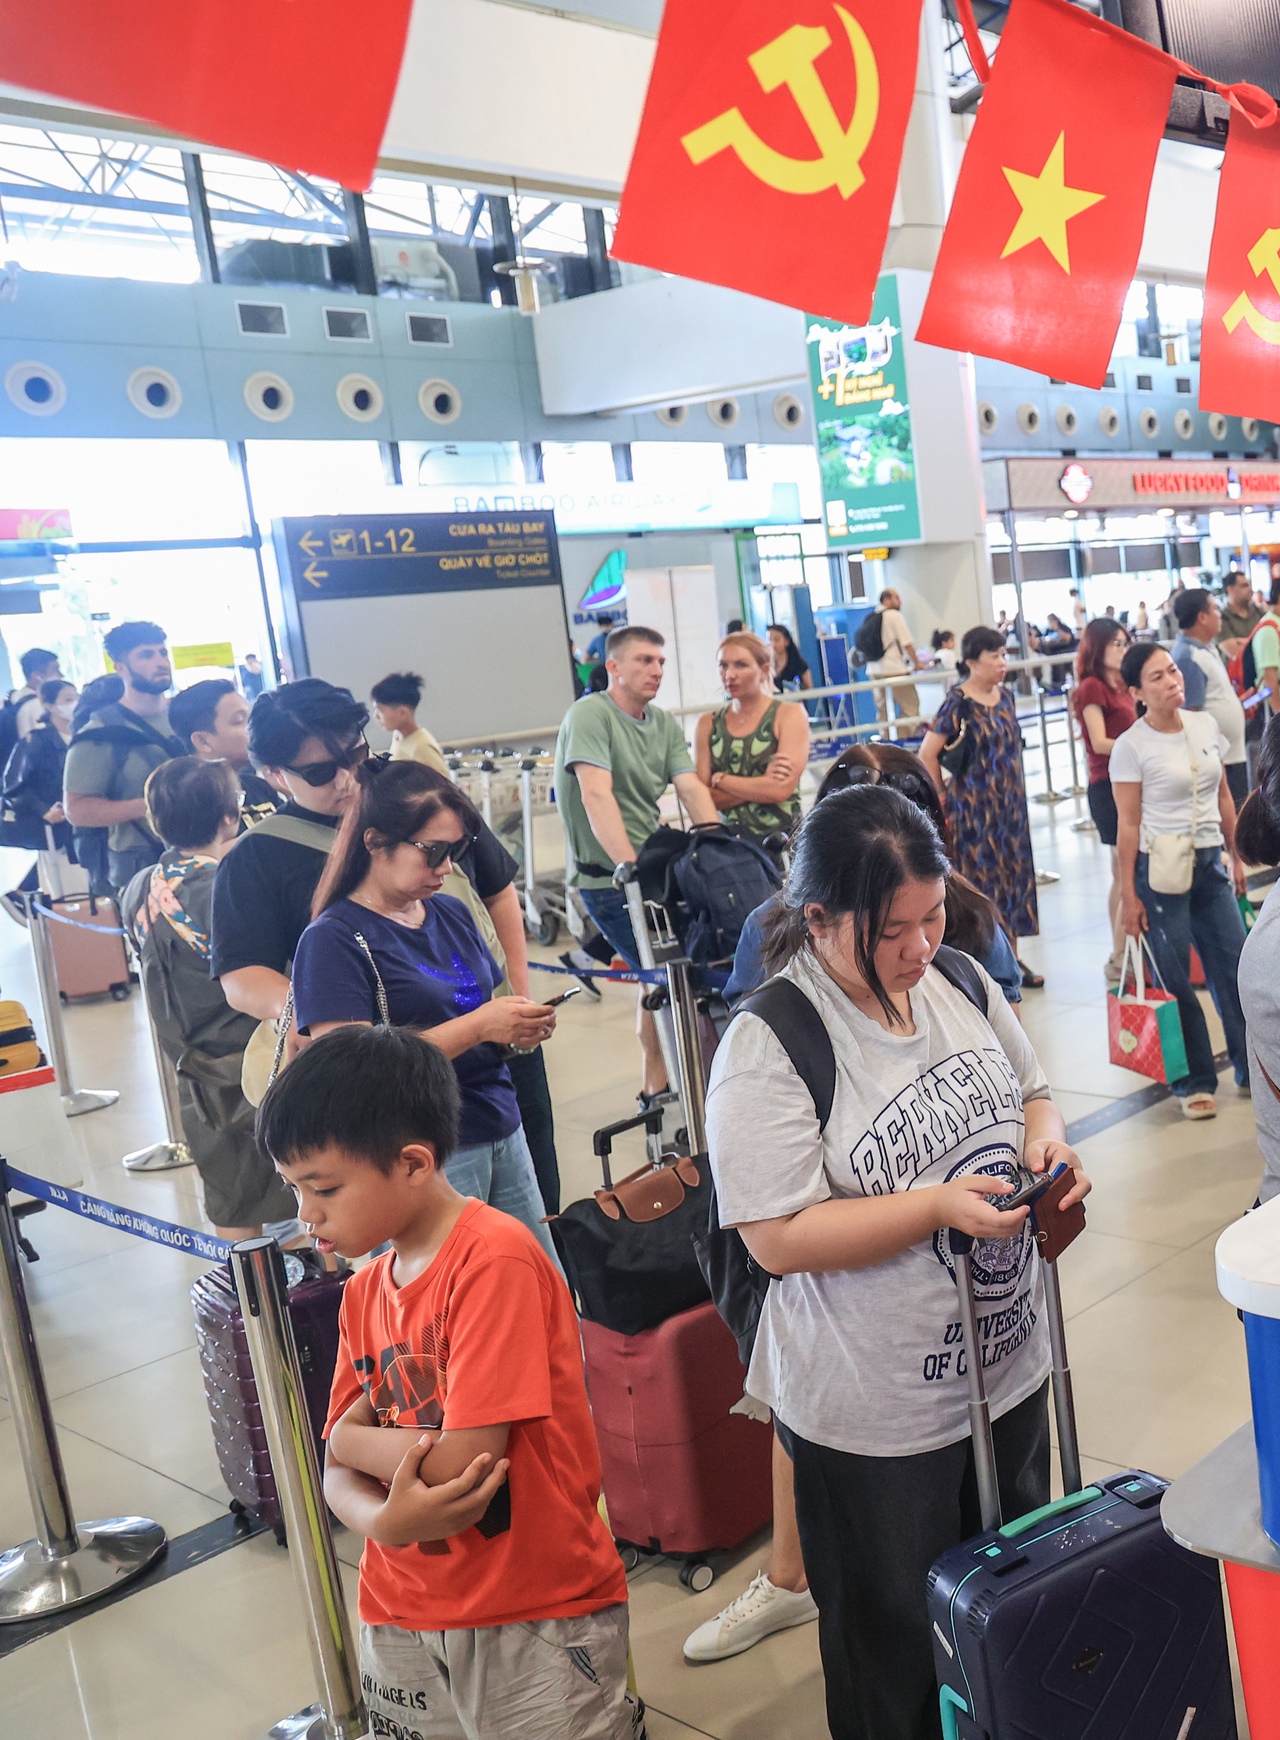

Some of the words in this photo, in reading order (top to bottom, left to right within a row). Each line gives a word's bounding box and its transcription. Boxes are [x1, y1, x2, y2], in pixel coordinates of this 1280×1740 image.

[1186, 472, 1228, 494] FOOD
[358, 527, 417, 554] 1-12
[160, 1227, 191, 1248] QUỐC
[923, 1352, 951, 1381] OF
[956, 1310, 1037, 1376] CLIFORNIA
